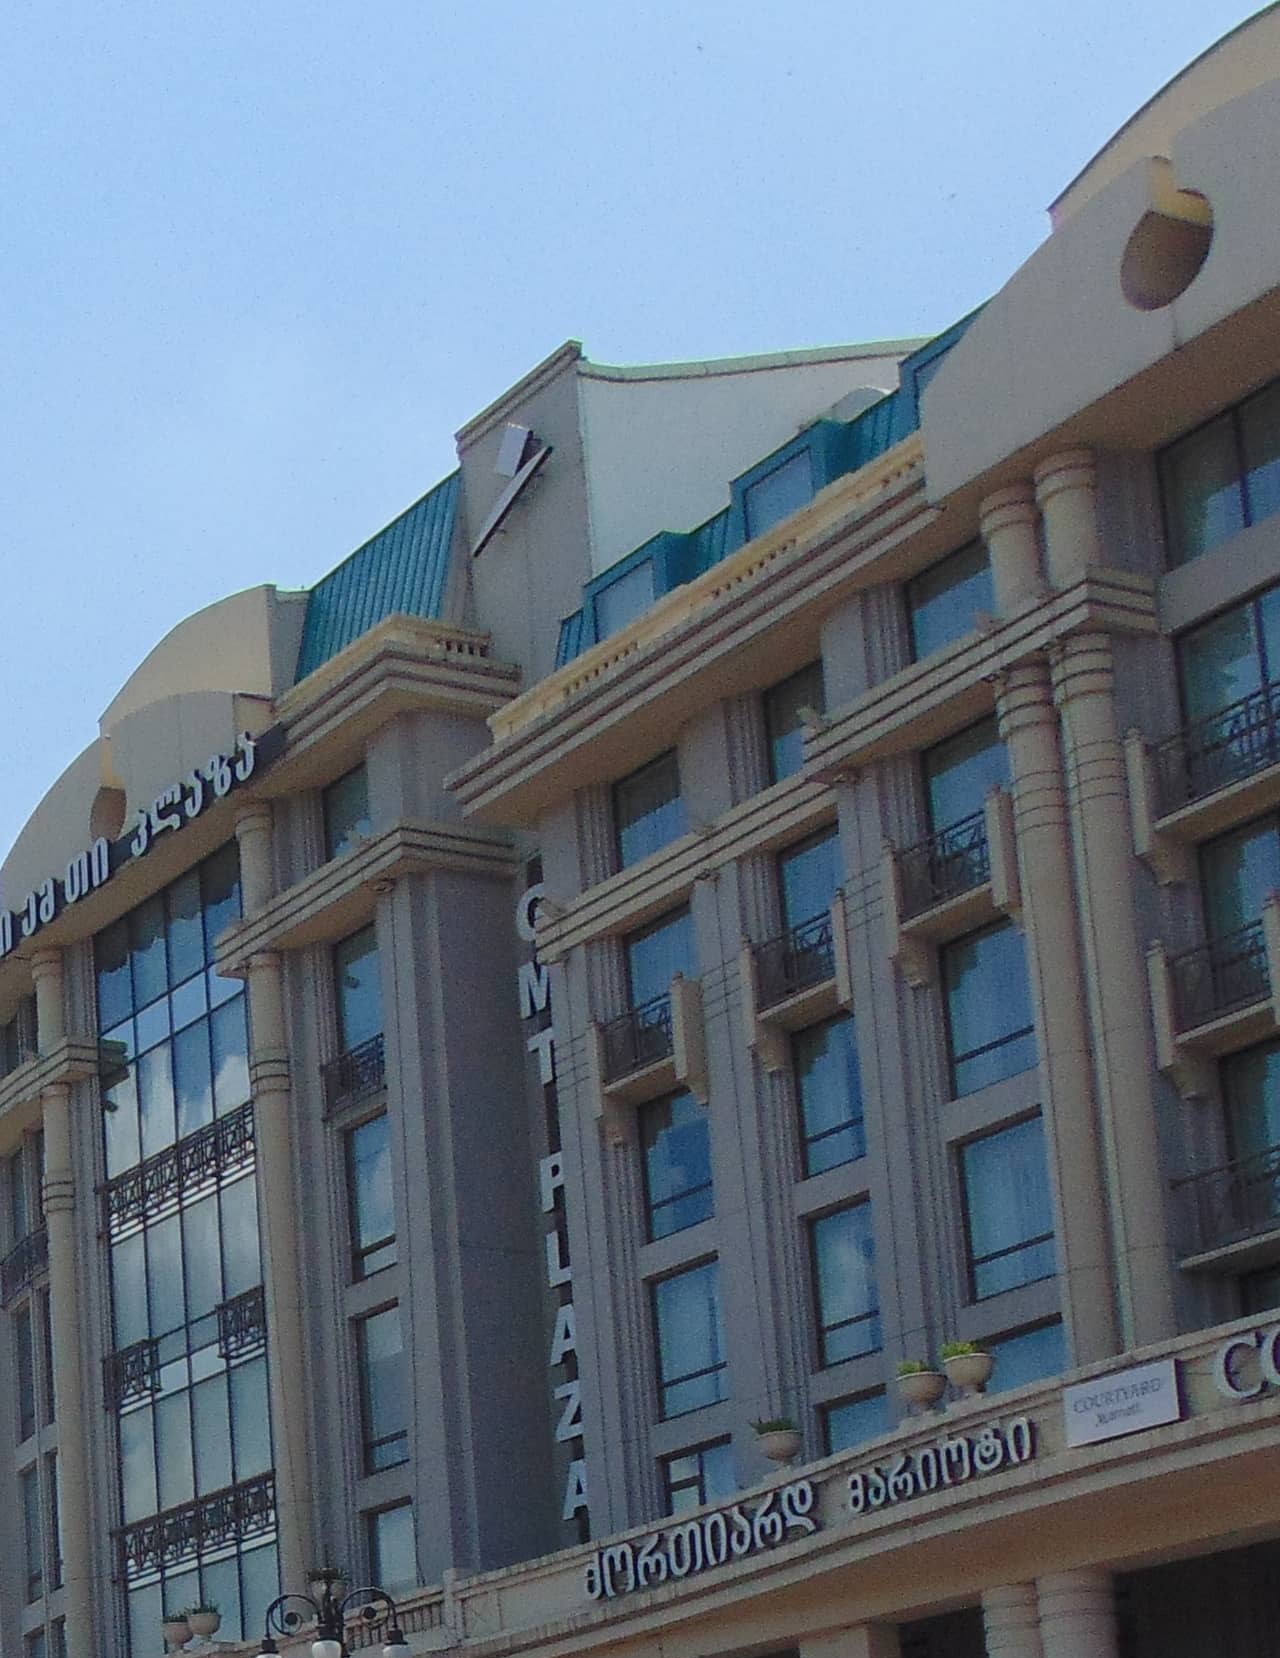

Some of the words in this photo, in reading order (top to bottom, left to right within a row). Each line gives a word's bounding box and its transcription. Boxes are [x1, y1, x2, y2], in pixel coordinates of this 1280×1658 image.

[540, 1151, 589, 1521] PLAZA
[1073, 1377, 1162, 1414] COURTYARD
[847, 1416, 1031, 1514] მარიოტი
